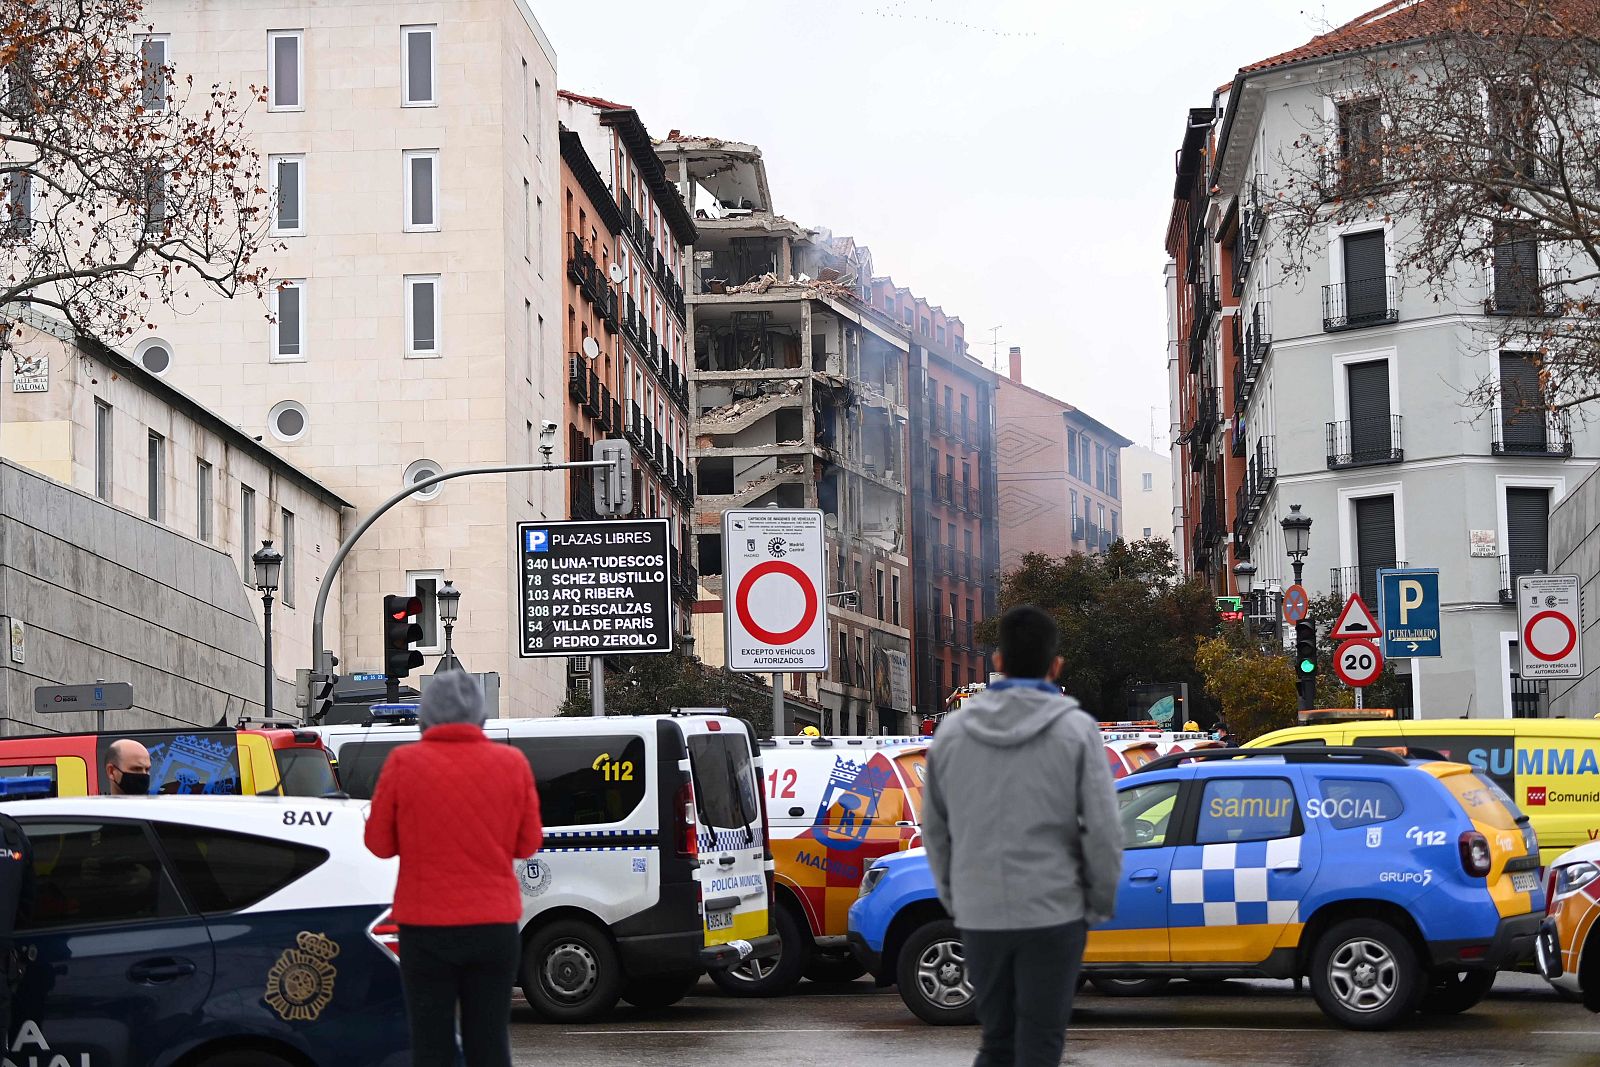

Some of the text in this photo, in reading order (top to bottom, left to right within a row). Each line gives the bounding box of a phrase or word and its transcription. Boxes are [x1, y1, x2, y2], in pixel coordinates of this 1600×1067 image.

[552, 532, 651, 545] PLAZAS LIBRES
[527, 555, 664, 569] 340 LUNA-TUDESCOS
[527, 571, 664, 586] 78 SCHEZ BUSTILLO
[527, 587, 634, 602] 103 ARQ RIBERA
[1399, 580, 1424, 624] P
[528, 603, 652, 616] 308 PZ DESCALZAS
[528, 616, 654, 632] 54 VILLA DE PARÍS
[528, 634, 657, 648] 28 PEDRO ZEROLO
[1388, 629, 1410, 640] PUERTA
[1414, 629, 1437, 640] TOLEDO
[1344, 654, 1372, 670] 20
[1467, 749, 1599, 775] SUMMA
[602, 761, 633, 781] 112
[764, 768, 798, 799] 12
[1209, 798, 1387, 818] samur SOCIAL
[282, 810, 333, 826] 8AV
[1412, 830, 1447, 846] 112
[795, 850, 859, 880] MADRID
